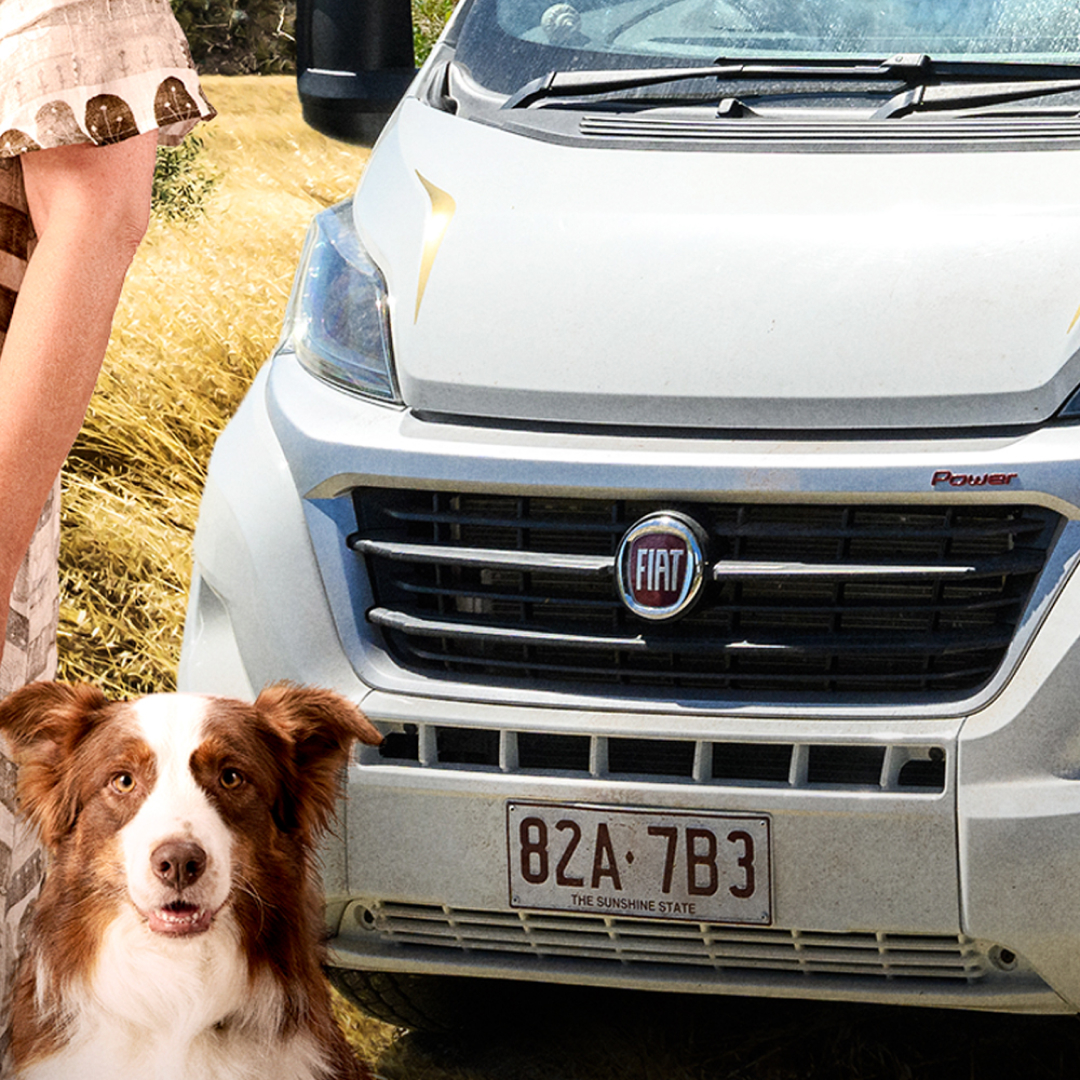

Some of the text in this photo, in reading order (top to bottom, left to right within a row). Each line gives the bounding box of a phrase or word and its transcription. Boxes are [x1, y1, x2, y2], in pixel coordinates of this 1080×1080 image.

[930, 469, 1018, 487] Power
[635, 548, 684, 591] FIAT
[571, 893, 696, 914] THE SUNSHINE STATE
